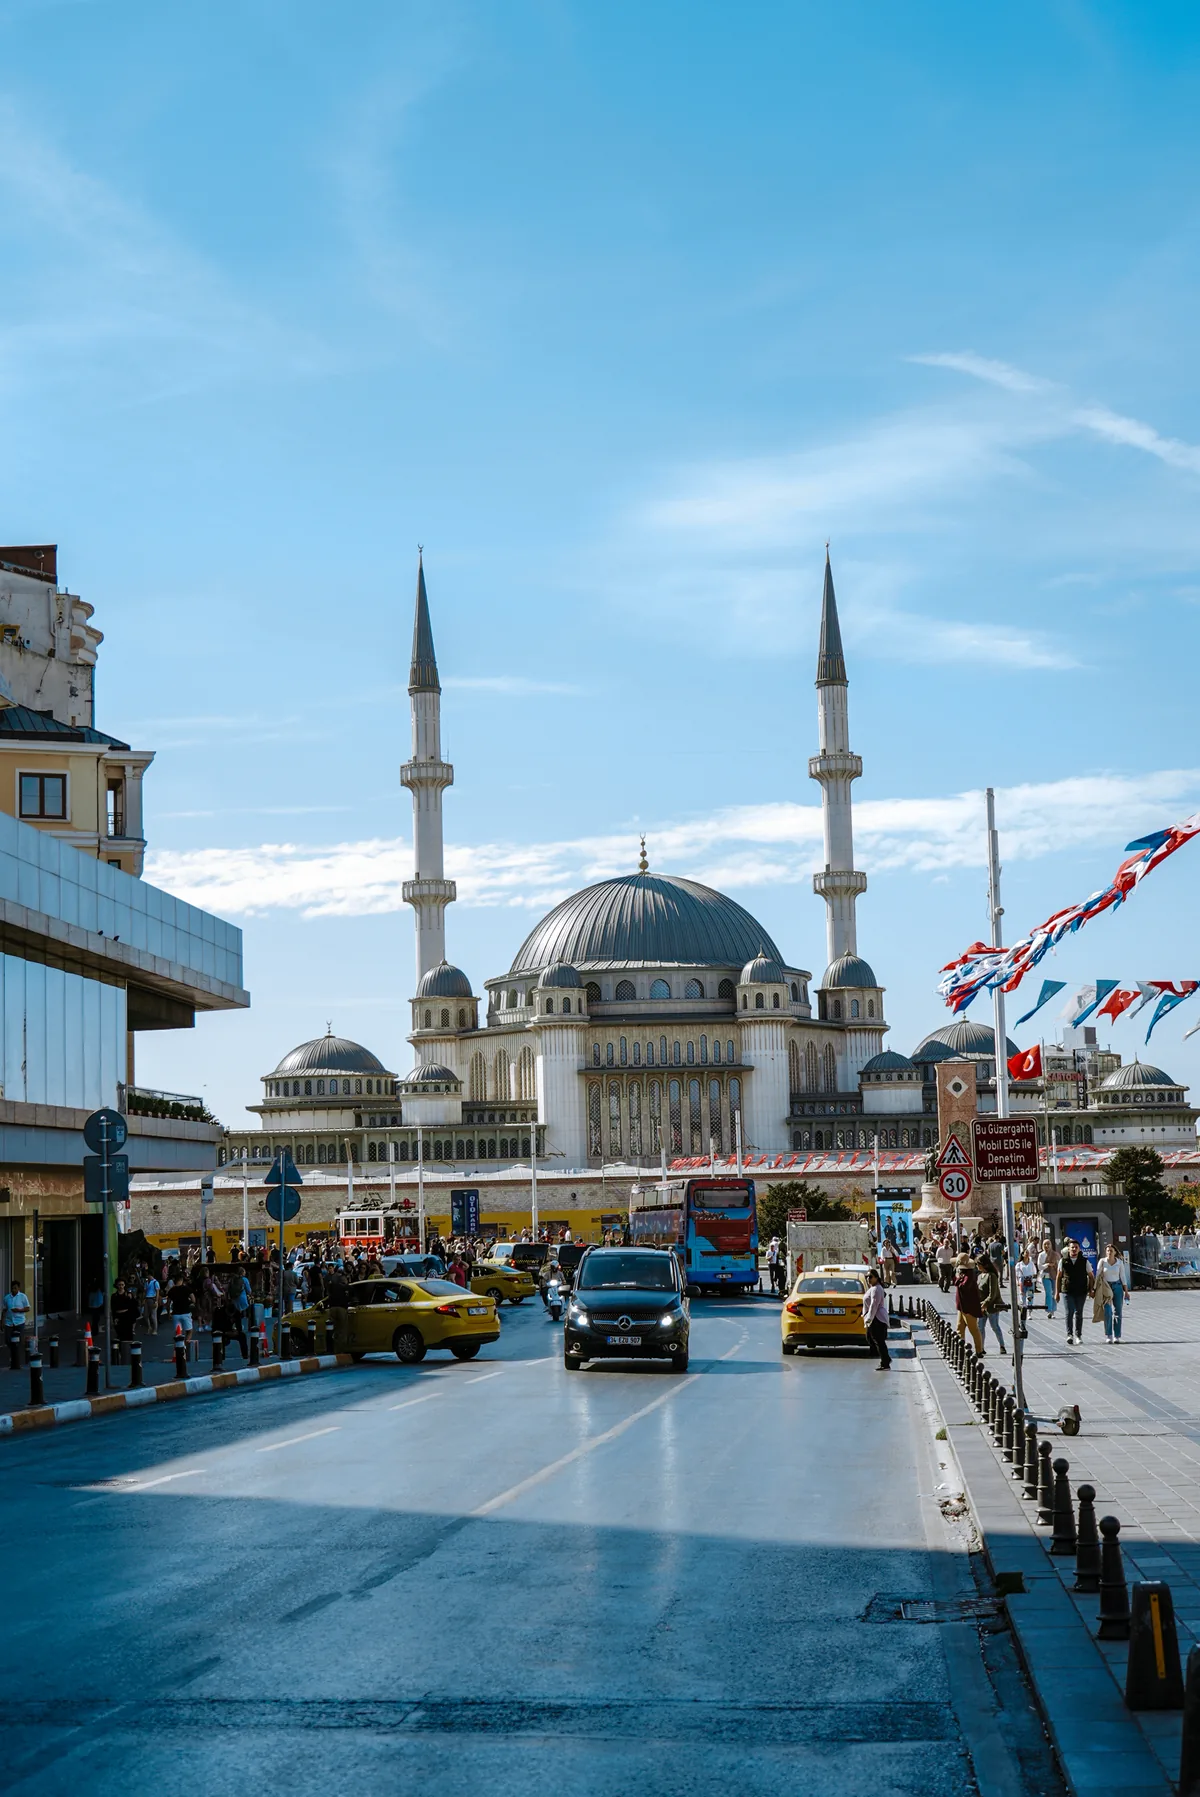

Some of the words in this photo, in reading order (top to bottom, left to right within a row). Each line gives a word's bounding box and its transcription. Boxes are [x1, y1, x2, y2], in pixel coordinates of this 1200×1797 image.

[975, 1124, 987, 1135] Bu
[987, 1122, 1034, 1136] Güzergahta
[978, 1139, 1002, 1150] Mobil
[1003, 1138, 1021, 1149] EDS
[1021, 1138, 1032, 1149] ile
[988, 1153, 1025, 1164] Denetim
[977, 1165, 1036, 1180] Yapılmaktadır
[945, 1177, 966, 1193] 30
